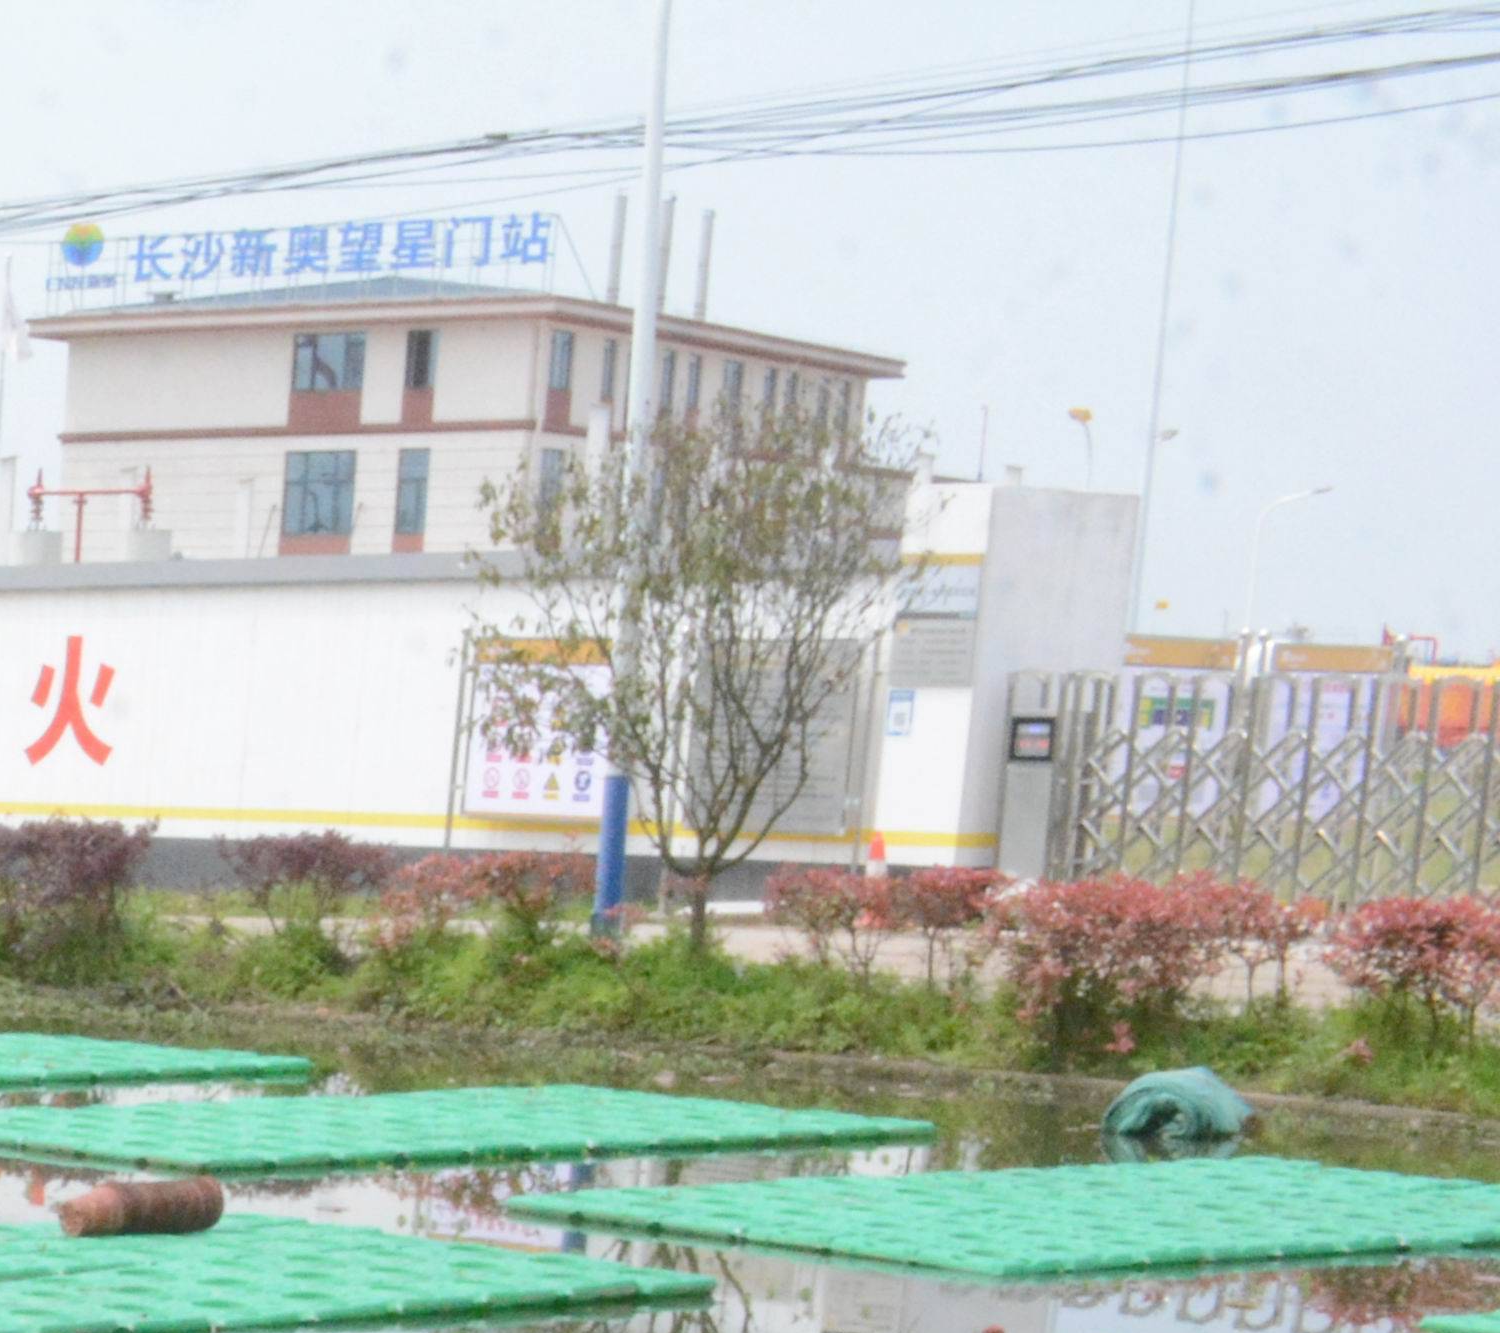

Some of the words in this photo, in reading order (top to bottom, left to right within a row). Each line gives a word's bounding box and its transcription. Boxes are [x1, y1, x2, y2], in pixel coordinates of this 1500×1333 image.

[129, 211, 552, 283] 长沙新奥望星门站
